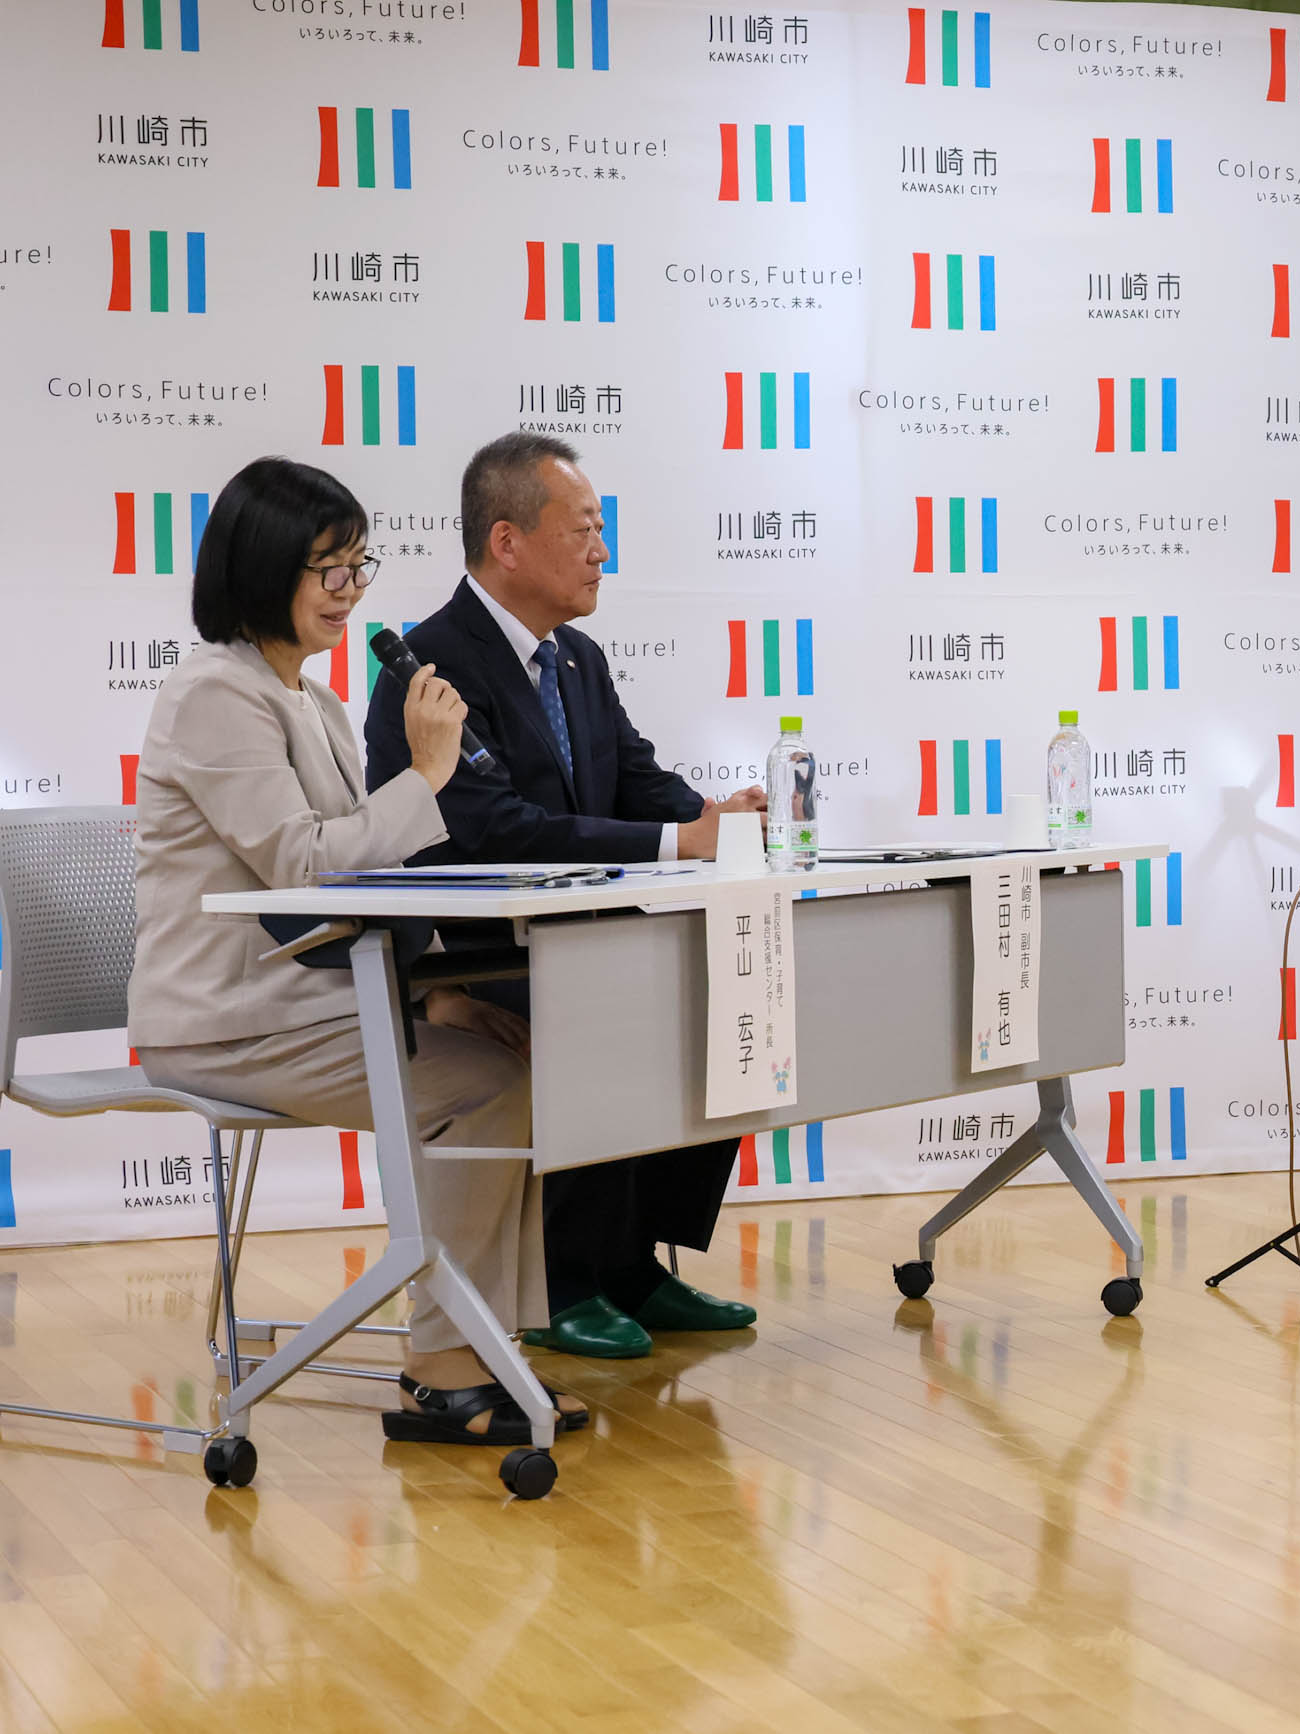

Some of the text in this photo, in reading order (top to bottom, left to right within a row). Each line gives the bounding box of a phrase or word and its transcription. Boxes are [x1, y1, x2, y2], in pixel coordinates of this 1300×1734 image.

[709, 15, 808, 45] 川崎市
[1134, 36, 1221, 56] Future!
[709, 52, 808, 64] KAWASAKI CITY
[98, 114, 207, 147] 川崎市
[569, 135, 666, 156] Future!
[98, 153, 208, 167] KAWASAKI CITY
[902, 146, 997, 176] 川崎市
[902, 182, 997, 195] KAWASAKI CITY
[313, 252, 419, 283] 川崎市
[768, 266, 861, 285] Future!
[313, 291, 419, 302] KAWASAKI CITY
[1088, 272, 1180, 301] 川崎市
[1089, 309, 1180, 318] KAWASAKI CITY
[162, 381, 266, 400] Future!
[518, 383, 624, 415] 川崎市
[958, 394, 1048, 412] Future!
[518, 422, 623, 435] KAWASAKI CITY
[373, 511, 463, 533] Future
[718, 510, 816, 540] 川崎市
[1140, 514, 1226, 531] Future!
[718, 548, 816, 559] KAWASAKI CITY
[108, 638, 200, 671] 川崎
[910, 633, 1004, 662] 川崎市
[108, 679, 165, 690] KAWAS
[910, 670, 1004, 680] KAWASAKI CITY
[819, 757, 868, 777] ure!
[1095, 748, 1185, 779] 川崎市
[2, 772, 62, 794] ure!
[1095, 785, 1186, 797] KAWASAKI CITY
[1019, 865, 1032, 990] 川崎市 副市長
[998, 875, 1011, 1046] 三田村 有也
[735, 914, 754, 1075] 平山 宏子
[1146, 986, 1231, 1004] Future!
[918, 1112, 1016, 1145] 川崎市
[918, 1146, 1006, 1163] KAWASAKI CIT
[123, 1193, 196, 1208] KAWASAKI
